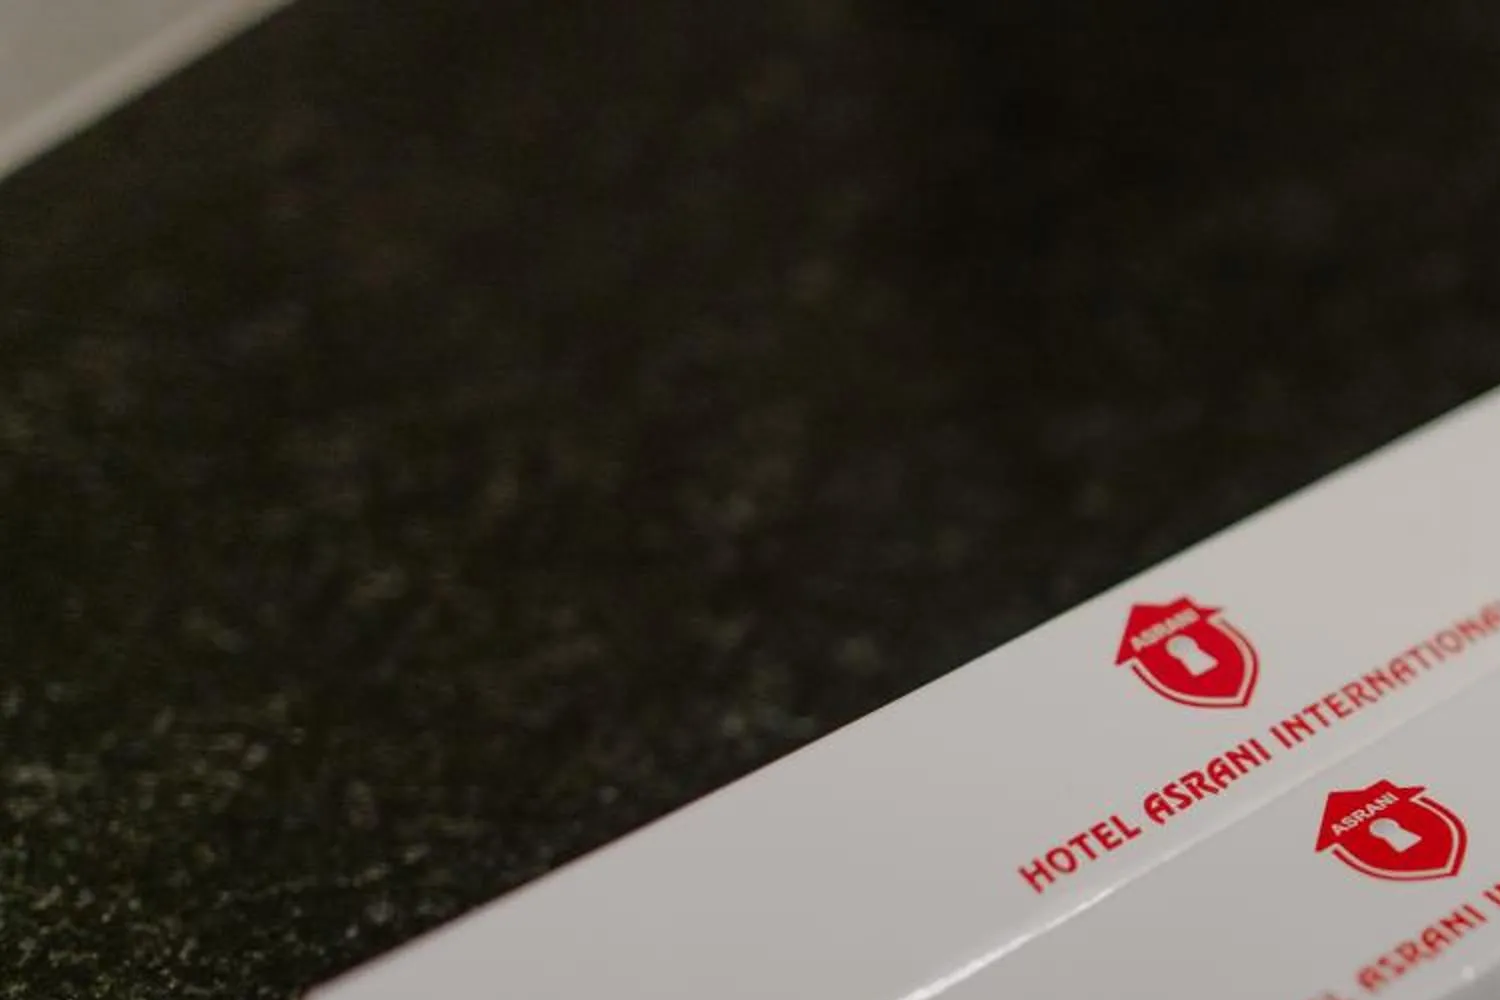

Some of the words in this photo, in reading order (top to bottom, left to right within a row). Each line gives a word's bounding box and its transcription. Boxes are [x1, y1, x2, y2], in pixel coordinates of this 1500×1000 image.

[1130, 607, 1200, 652] ASRANI
[1018, 815, 1142, 893] HOTEL
[1143, 738, 1272, 824] ASRANI
[1331, 792, 1399, 836] ASRANI
[1355, 904, 1489, 992] ASRANI
